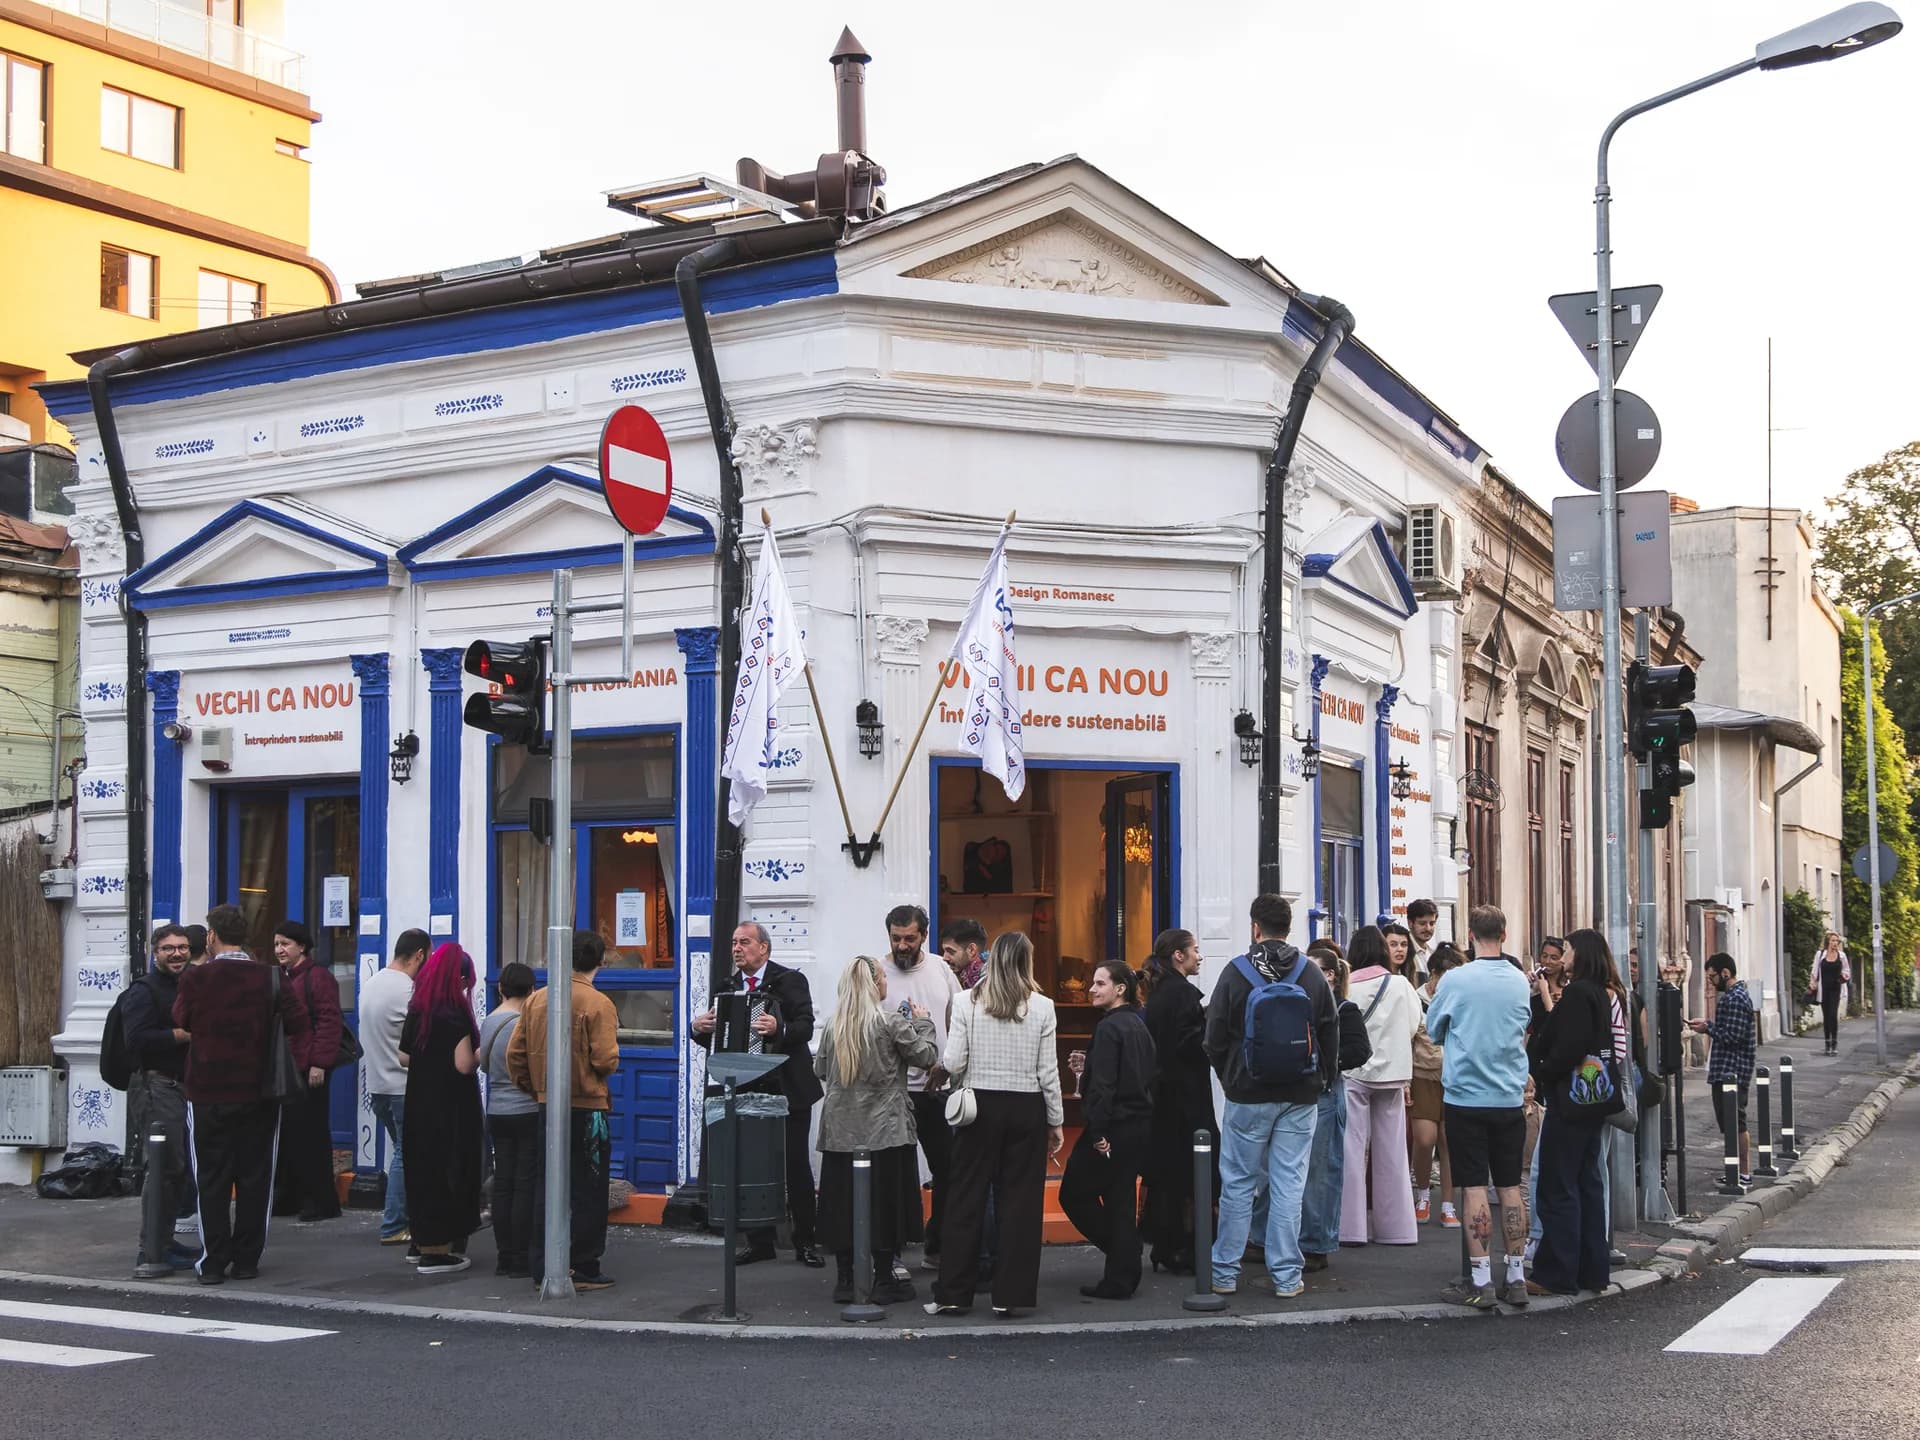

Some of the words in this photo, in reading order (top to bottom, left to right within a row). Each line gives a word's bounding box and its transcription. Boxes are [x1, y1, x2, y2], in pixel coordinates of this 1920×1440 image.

[1052, 588, 1115, 602] Romanesc
[1044, 664, 1090, 694] CA
[1098, 667, 1169, 697] NOU
[195, 690, 261, 716] VECHI
[266, 687, 297, 712] CA
[303, 682, 354, 709] NOU
[1337, 697, 1347, 720] CA
[1348, 700, 1365, 725] NOU
[244, 733, 297, 747] Întreprindere
